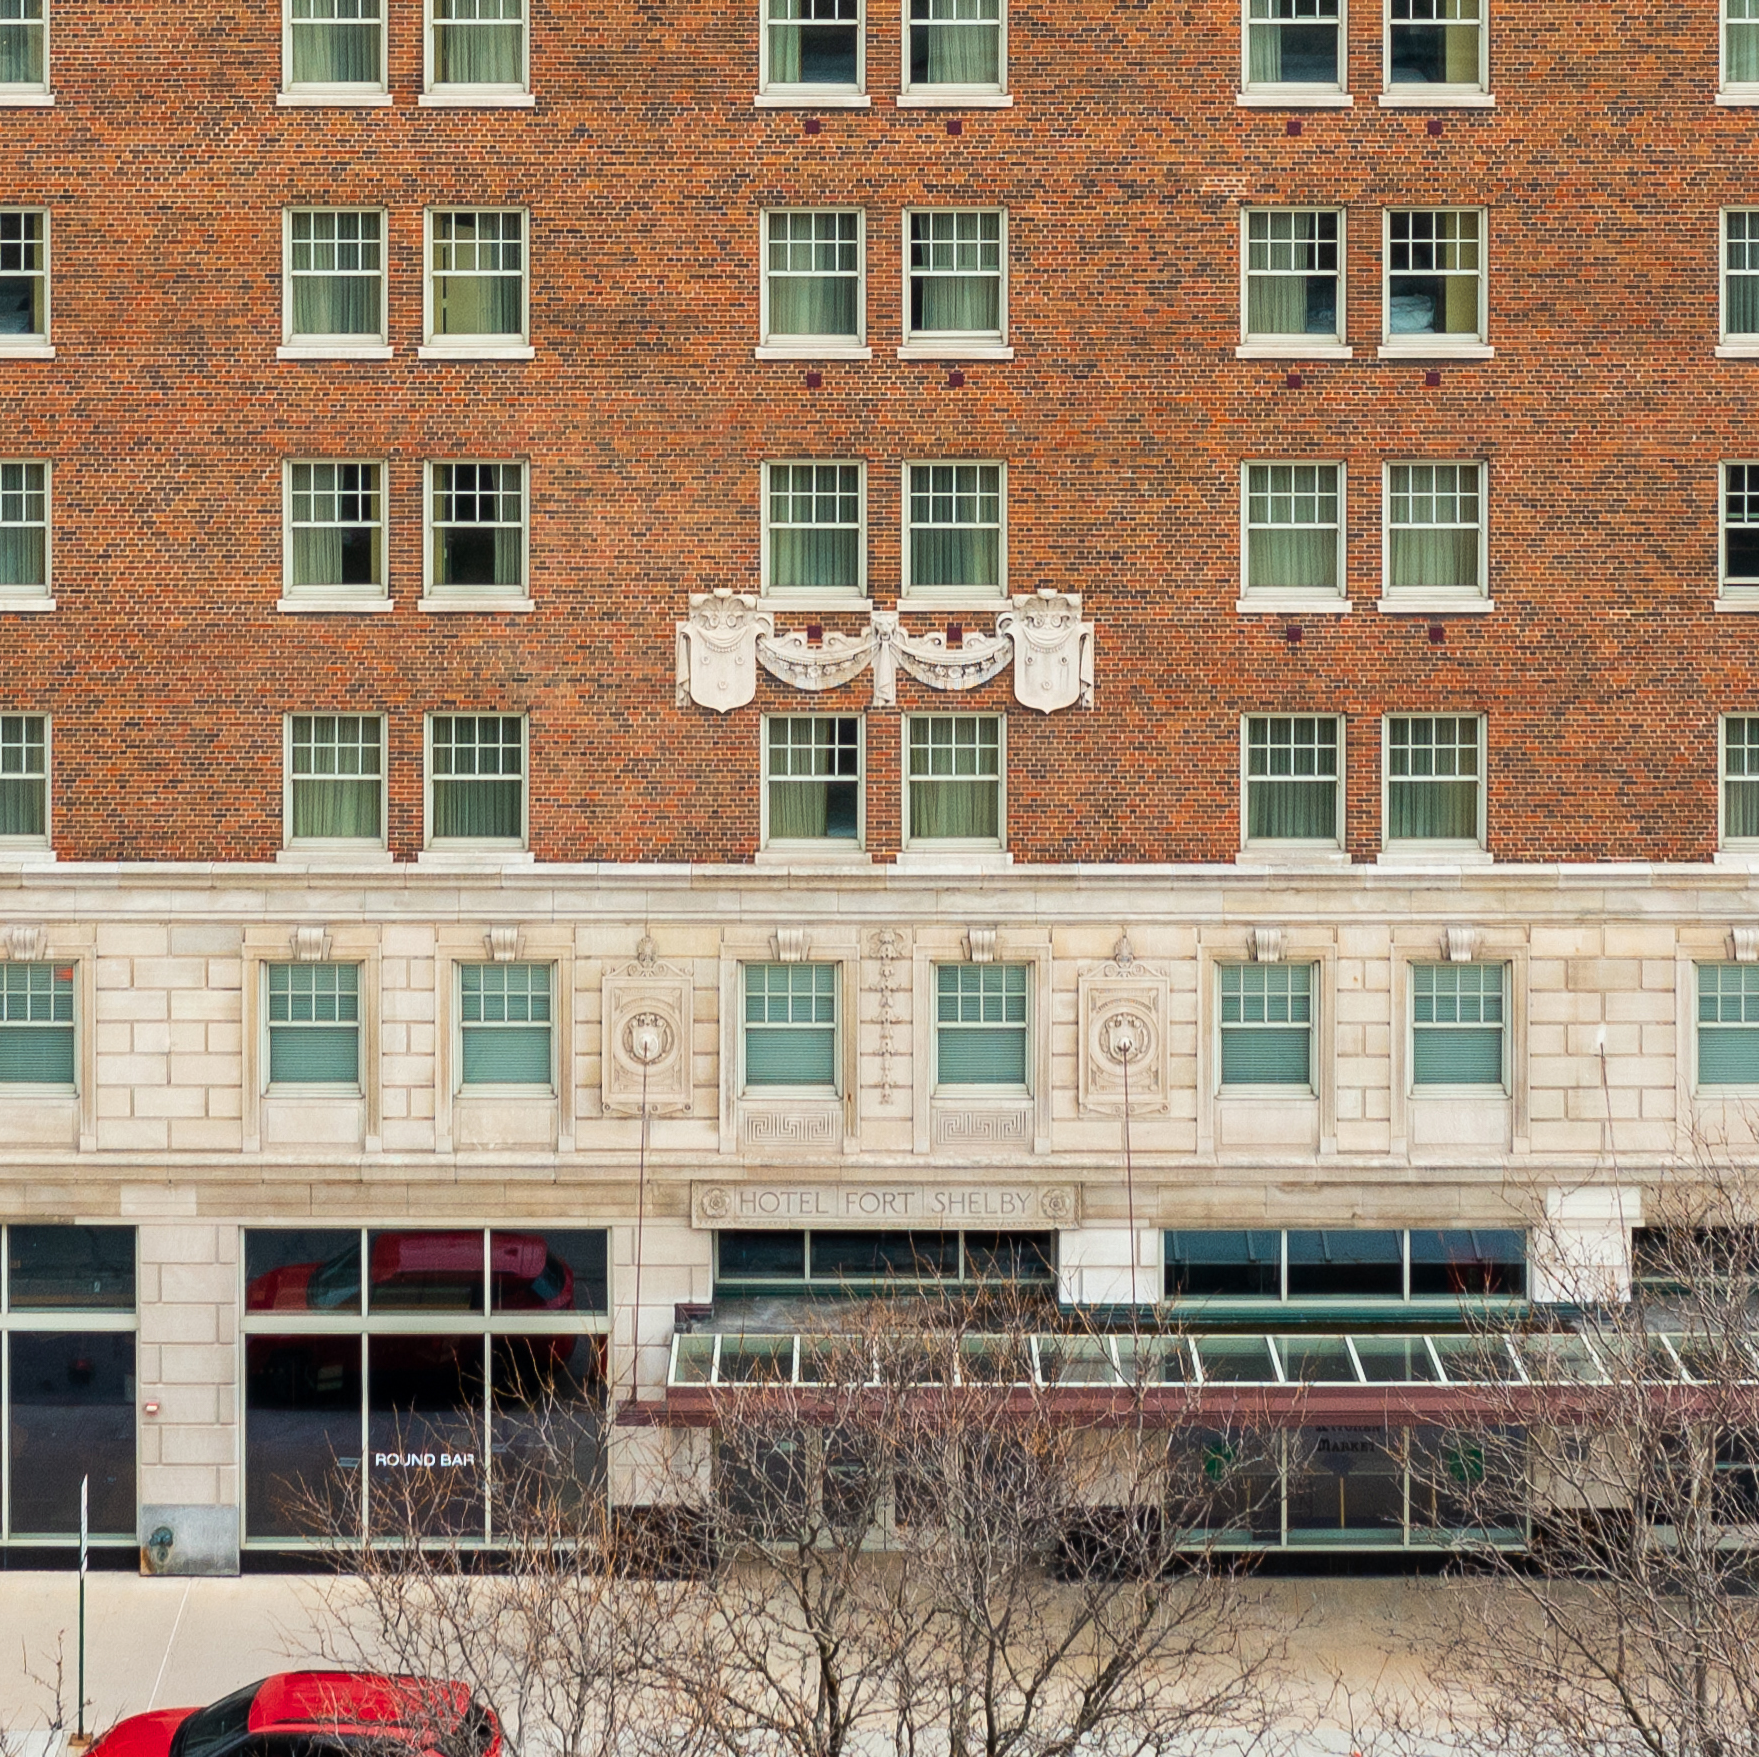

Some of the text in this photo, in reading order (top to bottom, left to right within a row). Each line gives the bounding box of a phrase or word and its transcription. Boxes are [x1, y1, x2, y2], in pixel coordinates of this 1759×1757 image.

[740, 1191, 1032, 1215] HOTEL FORT SHELBY
[1317, 1439, 1376, 1452] MARKET
[375, 1453, 475, 1467] ROUND BAR
